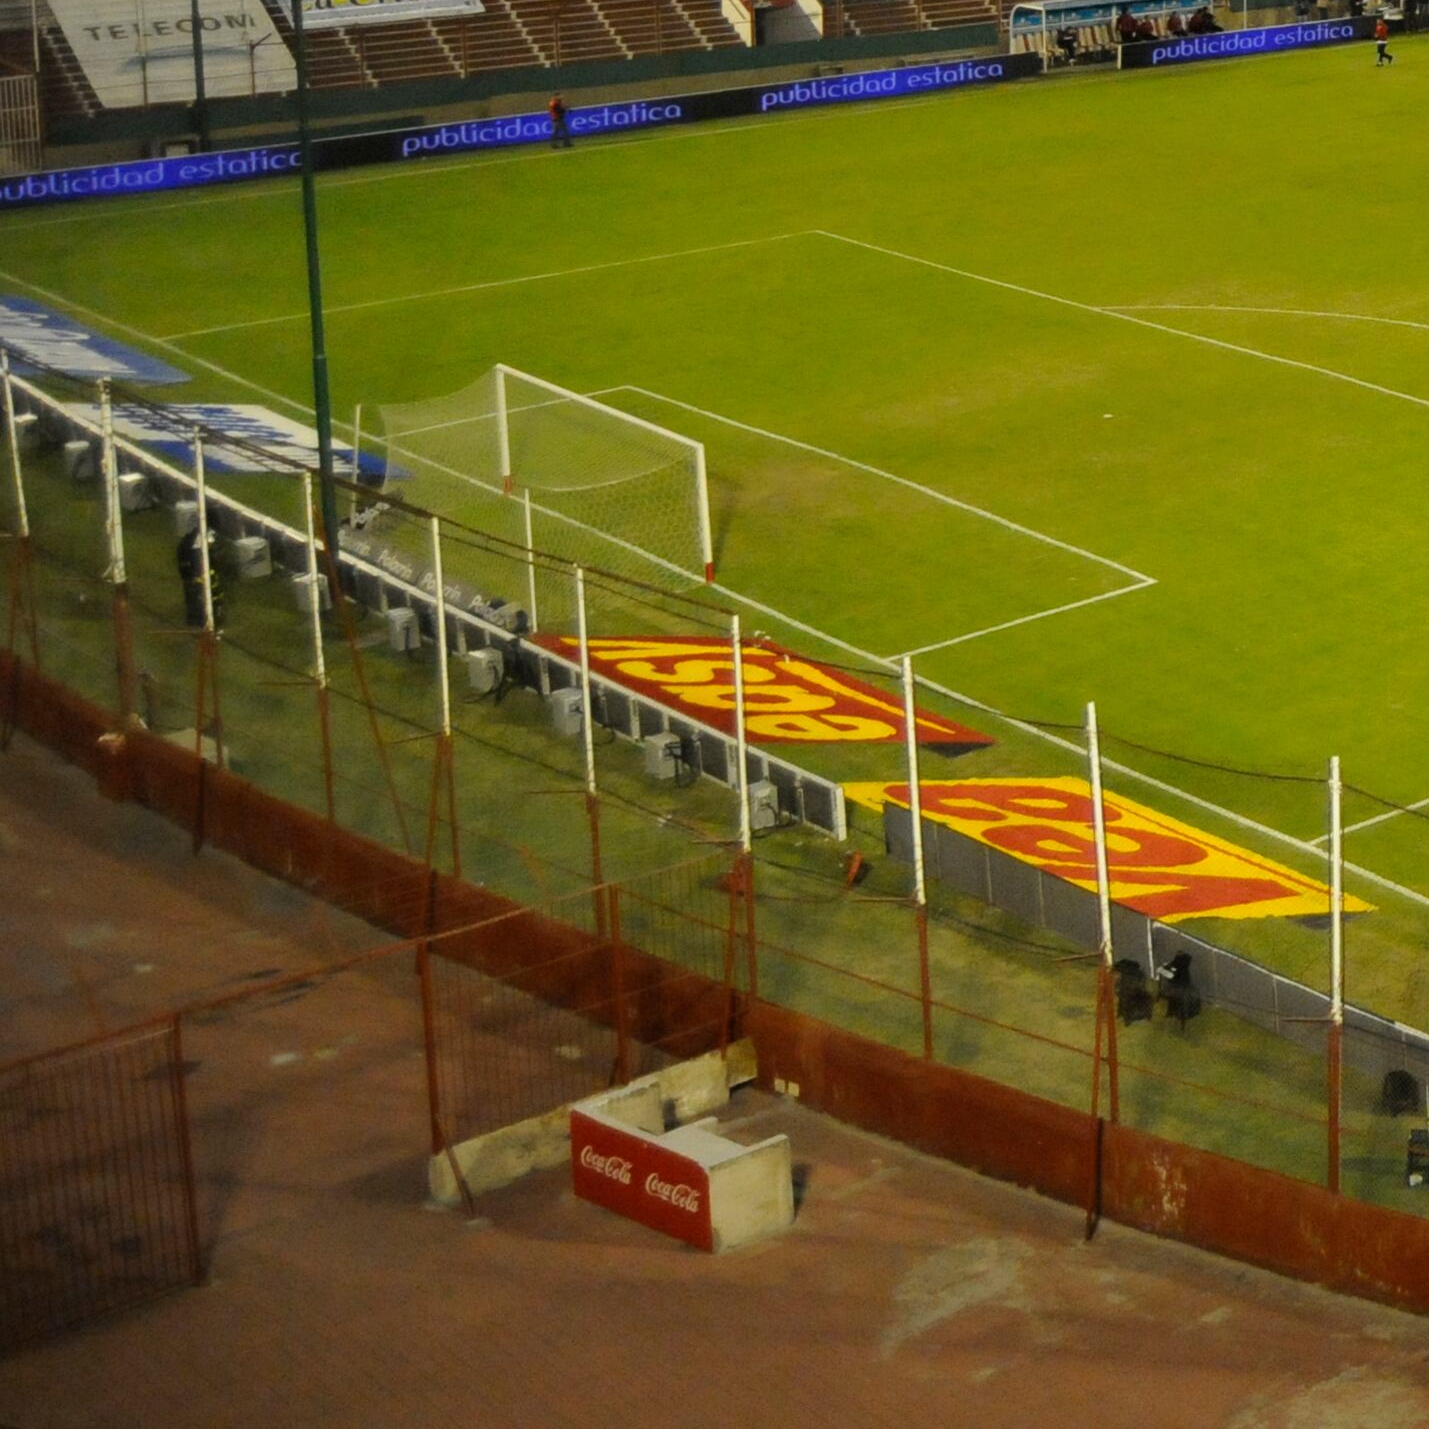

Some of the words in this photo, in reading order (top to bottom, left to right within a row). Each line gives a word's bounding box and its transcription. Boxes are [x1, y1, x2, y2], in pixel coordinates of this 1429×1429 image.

[1152, 30, 1266, 65] publicidad
[1274, 22, 1354, 46] estatica
[760, 72, 897, 112] publicidad
[907, 61, 1004, 88] estatica
[571, 102, 682, 131] estatica
